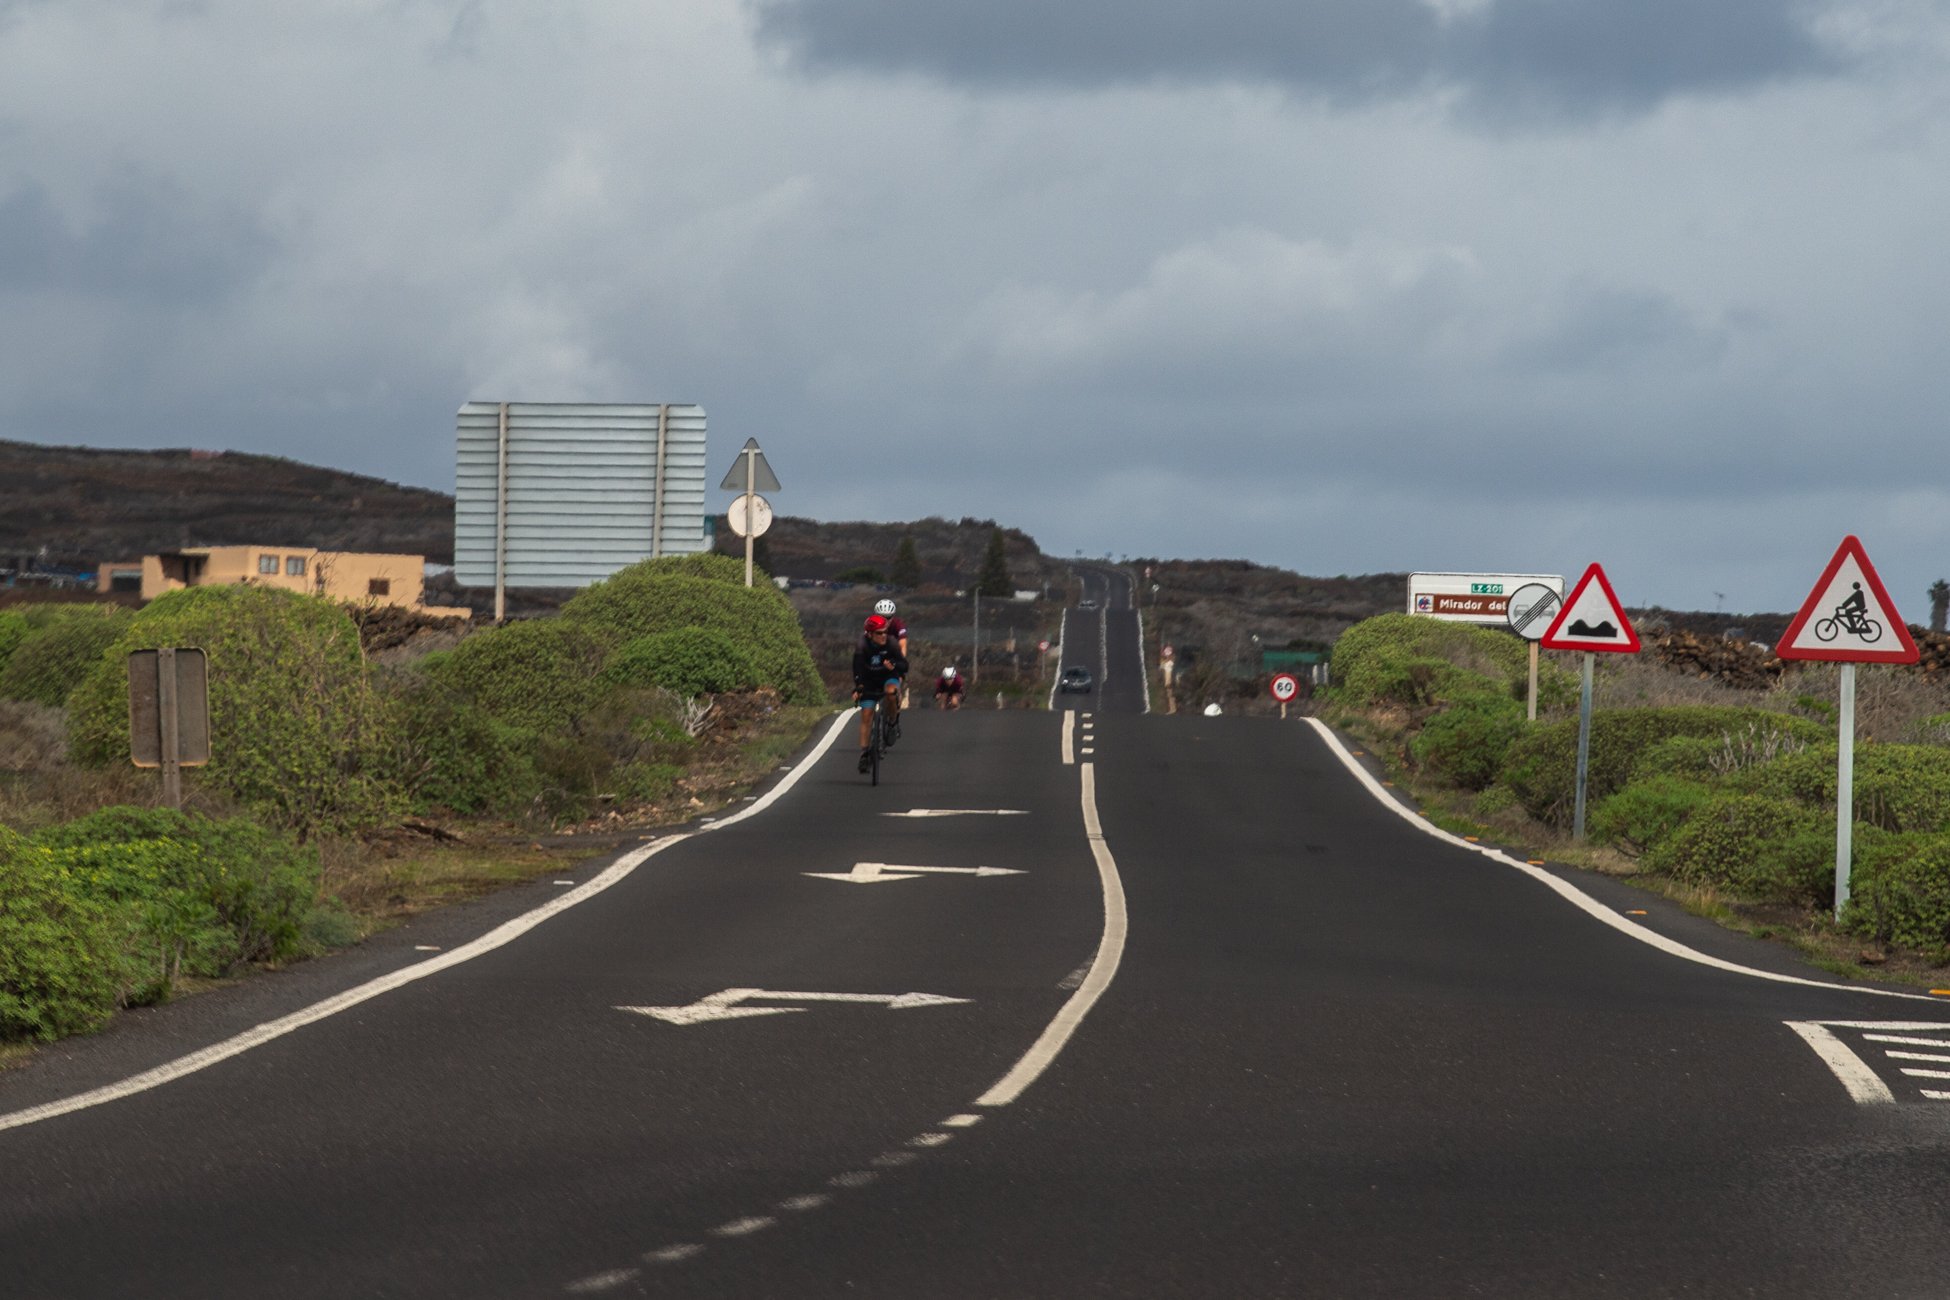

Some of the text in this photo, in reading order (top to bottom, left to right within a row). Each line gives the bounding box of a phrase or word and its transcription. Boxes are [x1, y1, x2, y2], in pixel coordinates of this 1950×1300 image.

[1472, 584, 1502, 593] LZ-201
[1439, 598, 1507, 610] Mirador del
[1277, 682, 1292, 691] 60
